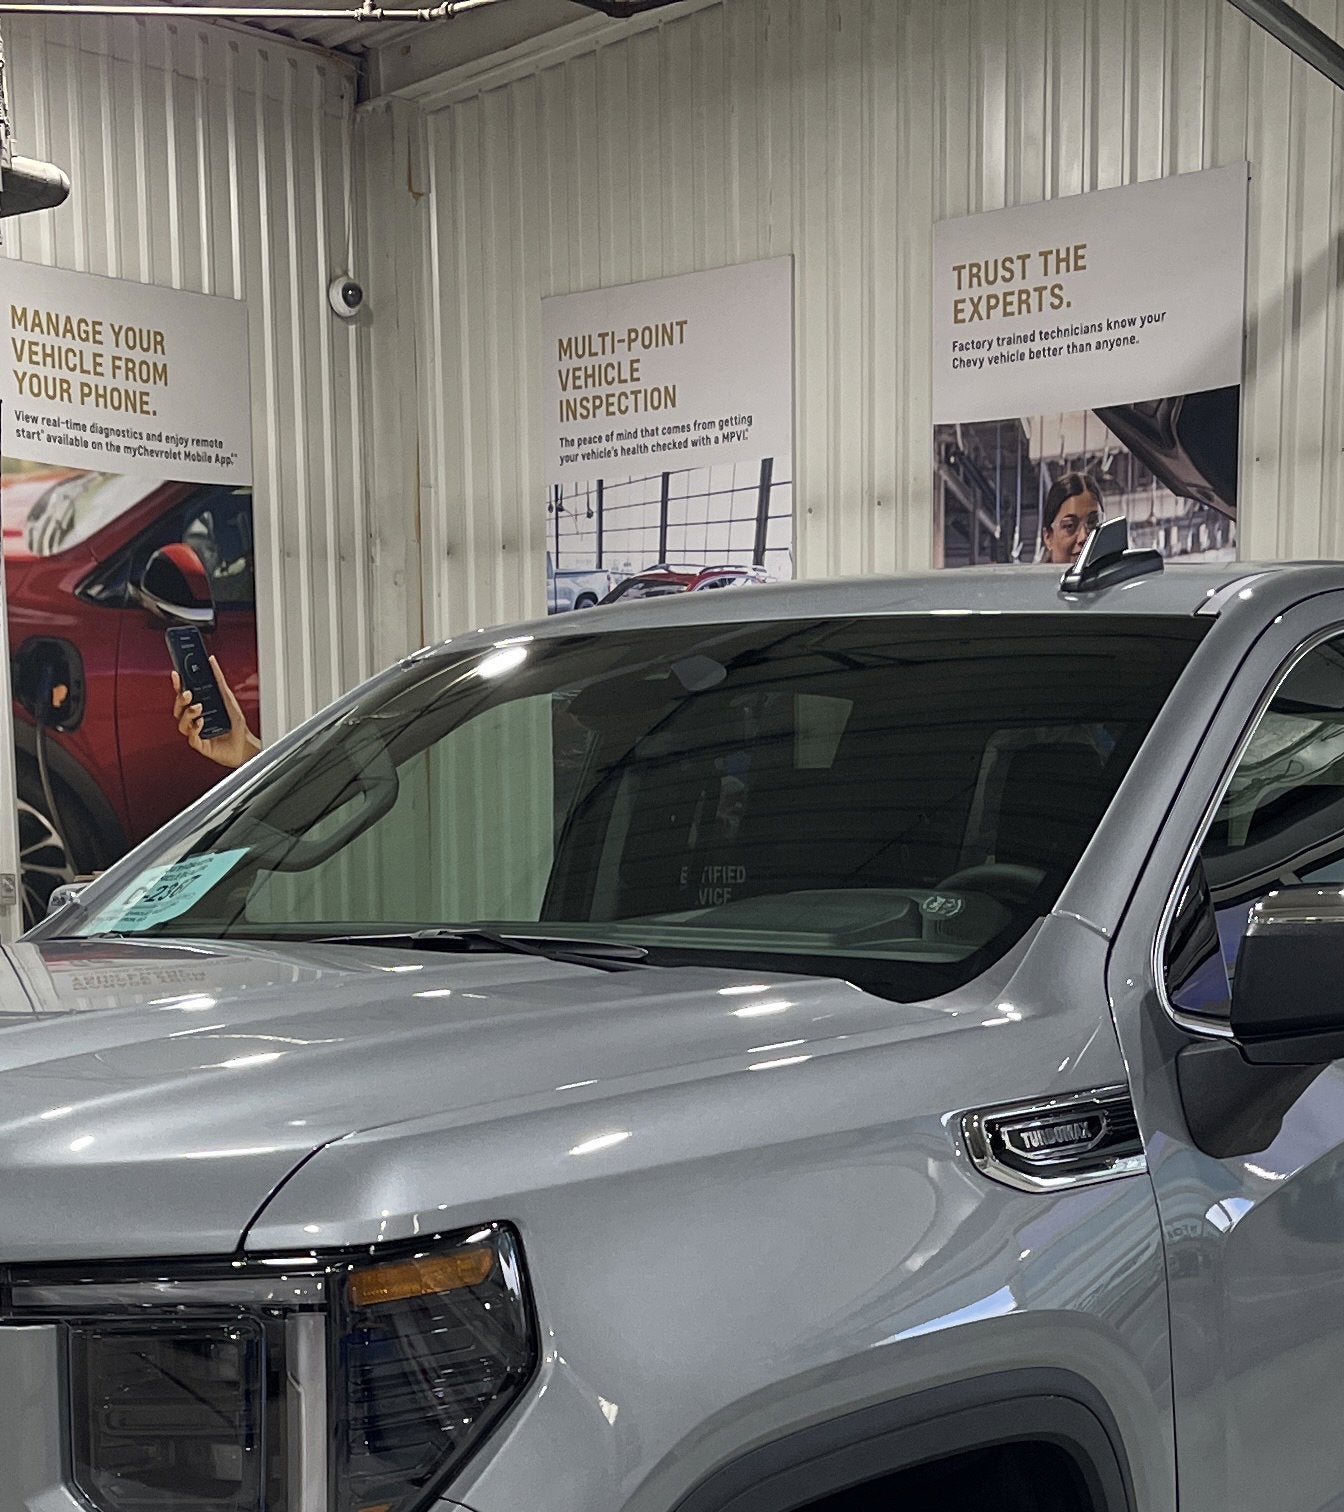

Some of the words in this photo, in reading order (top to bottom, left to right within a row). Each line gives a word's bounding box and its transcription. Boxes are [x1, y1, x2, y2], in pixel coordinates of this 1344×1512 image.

[952, 253, 1031, 290] TRUST
[1038, 243, 1088, 277] THE
[953, 283, 1072, 324] EXPERTS.
[10, 304, 104, 346] MANAGE
[109, 323, 166, 356] YOUR
[557, 319, 688, 362] MULTI-POINT
[952, 337, 994, 353] Factory
[996, 330, 1036, 346] trained
[1039, 321, 1104, 340] technicians
[1106, 316, 1137, 331] know
[1140, 311, 1167, 328] your
[10, 337, 105, 378] VEHICLE
[111, 355, 169, 387] FROM
[952, 355, 984, 370] Chevy
[987, 349, 1026, 366] vehicle
[1029, 346, 1063, 361] better
[1066, 342, 1092, 356] than
[1095, 335, 1140, 353] anyone.
[13, 369, 73, 404] YOUR
[79, 381, 157, 417] PHONE.
[557, 358, 641, 392] VEHICLE
[559, 384, 677, 423] INSPECTION
[14, 410, 39, 425] View
[41, 416, 87, 433] real-time
[89, 422, 144, 441] diagnostics
[145, 432, 163, 443] and
[165, 434, 189, 448] enjoy
[191, 437, 224, 449] remote
[46, 433, 88, 449] available
[92, 441, 103, 450] on
[105, 441, 121, 453] the
[123, 444, 182, 460] myChevrolet
[184, 452, 212, 464] Mobile
[559, 436, 575, 449] The
[577, 434, 603, 447] peace
[605, 430, 614, 443] of
[616, 428, 638, 441] mind
[640, 426, 659, 439] that
[661, 422, 691, 435] comes
[692, 419, 716, 432] from
[718, 414, 753, 430] getting
[559, 452, 579, 466] your
[581, 445, 619, 461] vehicle's
[620, 443, 649, 457] health
[651, 438, 689, 453] checked
[691, 436, 712, 448] with
[714, 436, 719, 446] a
